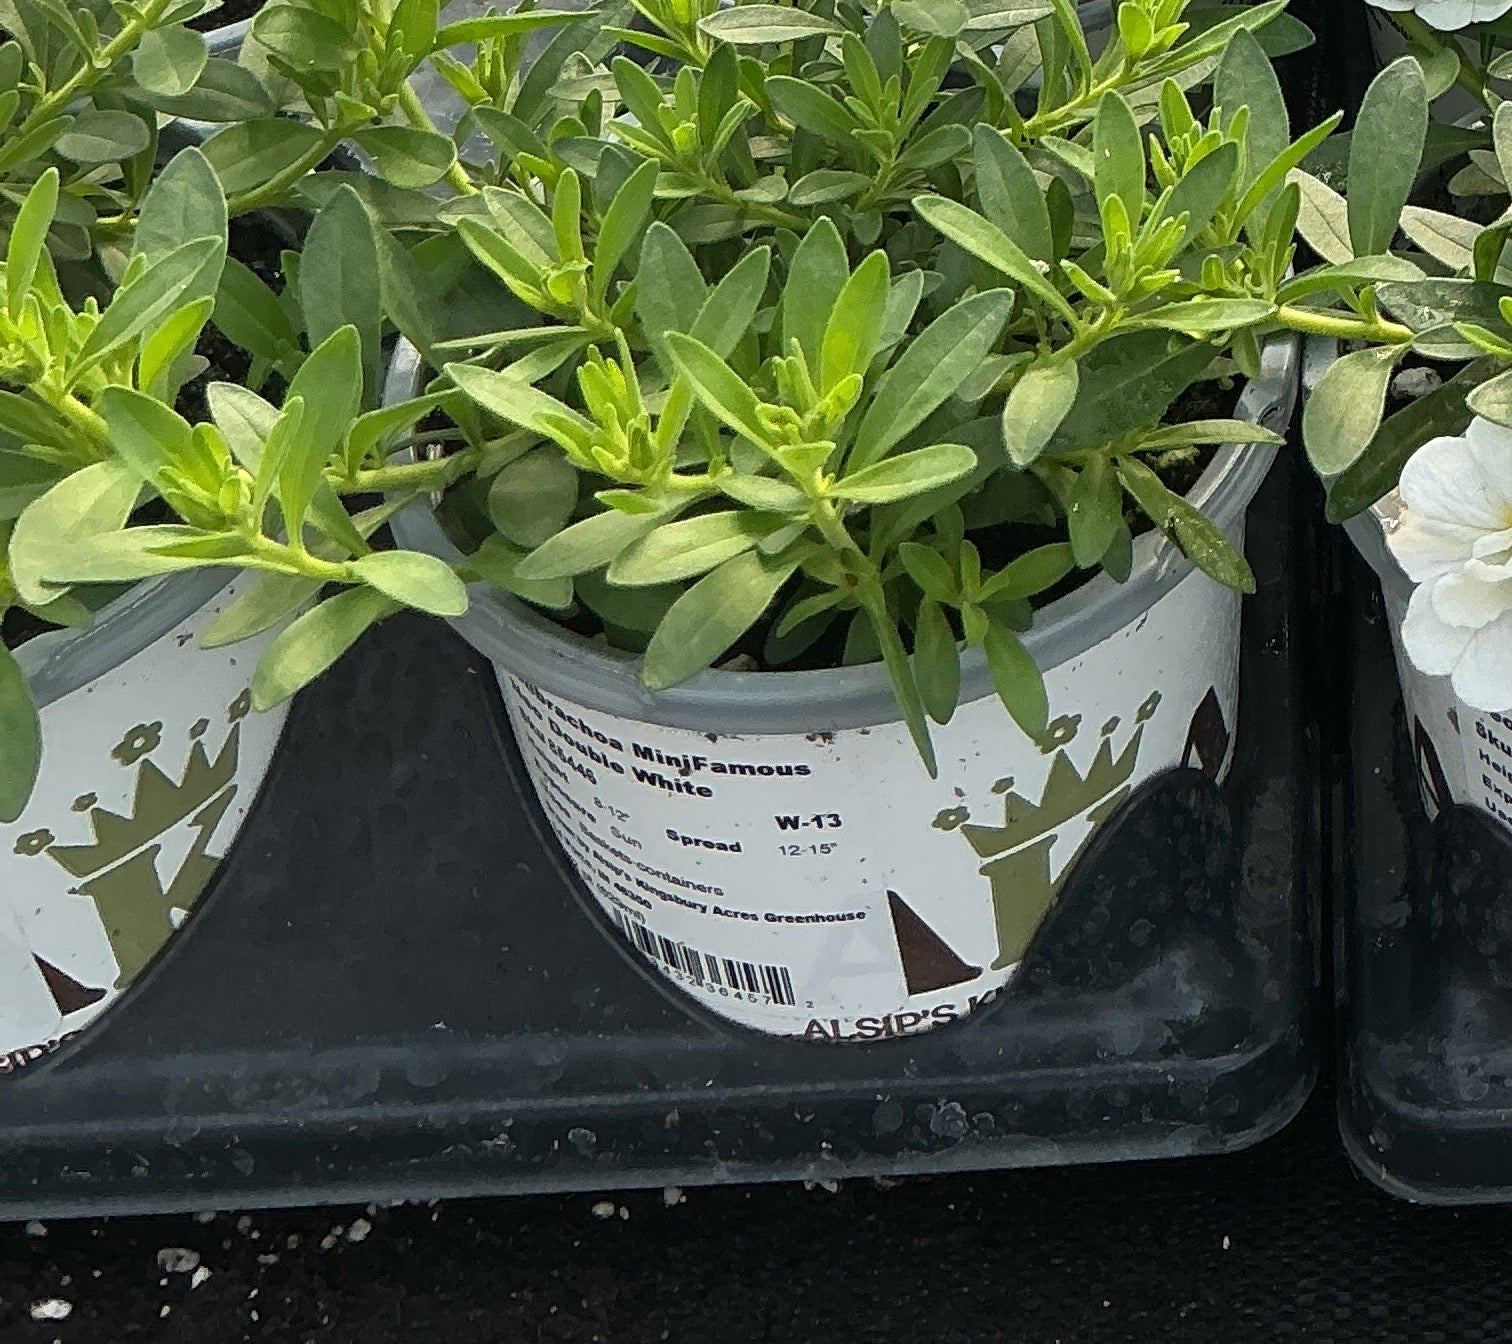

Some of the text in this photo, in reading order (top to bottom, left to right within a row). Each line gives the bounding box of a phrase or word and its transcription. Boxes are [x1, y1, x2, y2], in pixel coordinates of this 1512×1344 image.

[1475, 720, 1512, 758] Sku
[548, 716, 625, 775] Double
[631, 765, 713, 798] White
[631, 742, 812, 776] MiniFamous
[774, 812, 843, 832] W-13
[665, 828, 742, 853] Spread
[712, 905, 759, 922] Acres
[763, 910, 867, 924] Greenhouse
[804, 1002, 957, 1041] ALSIP'S
